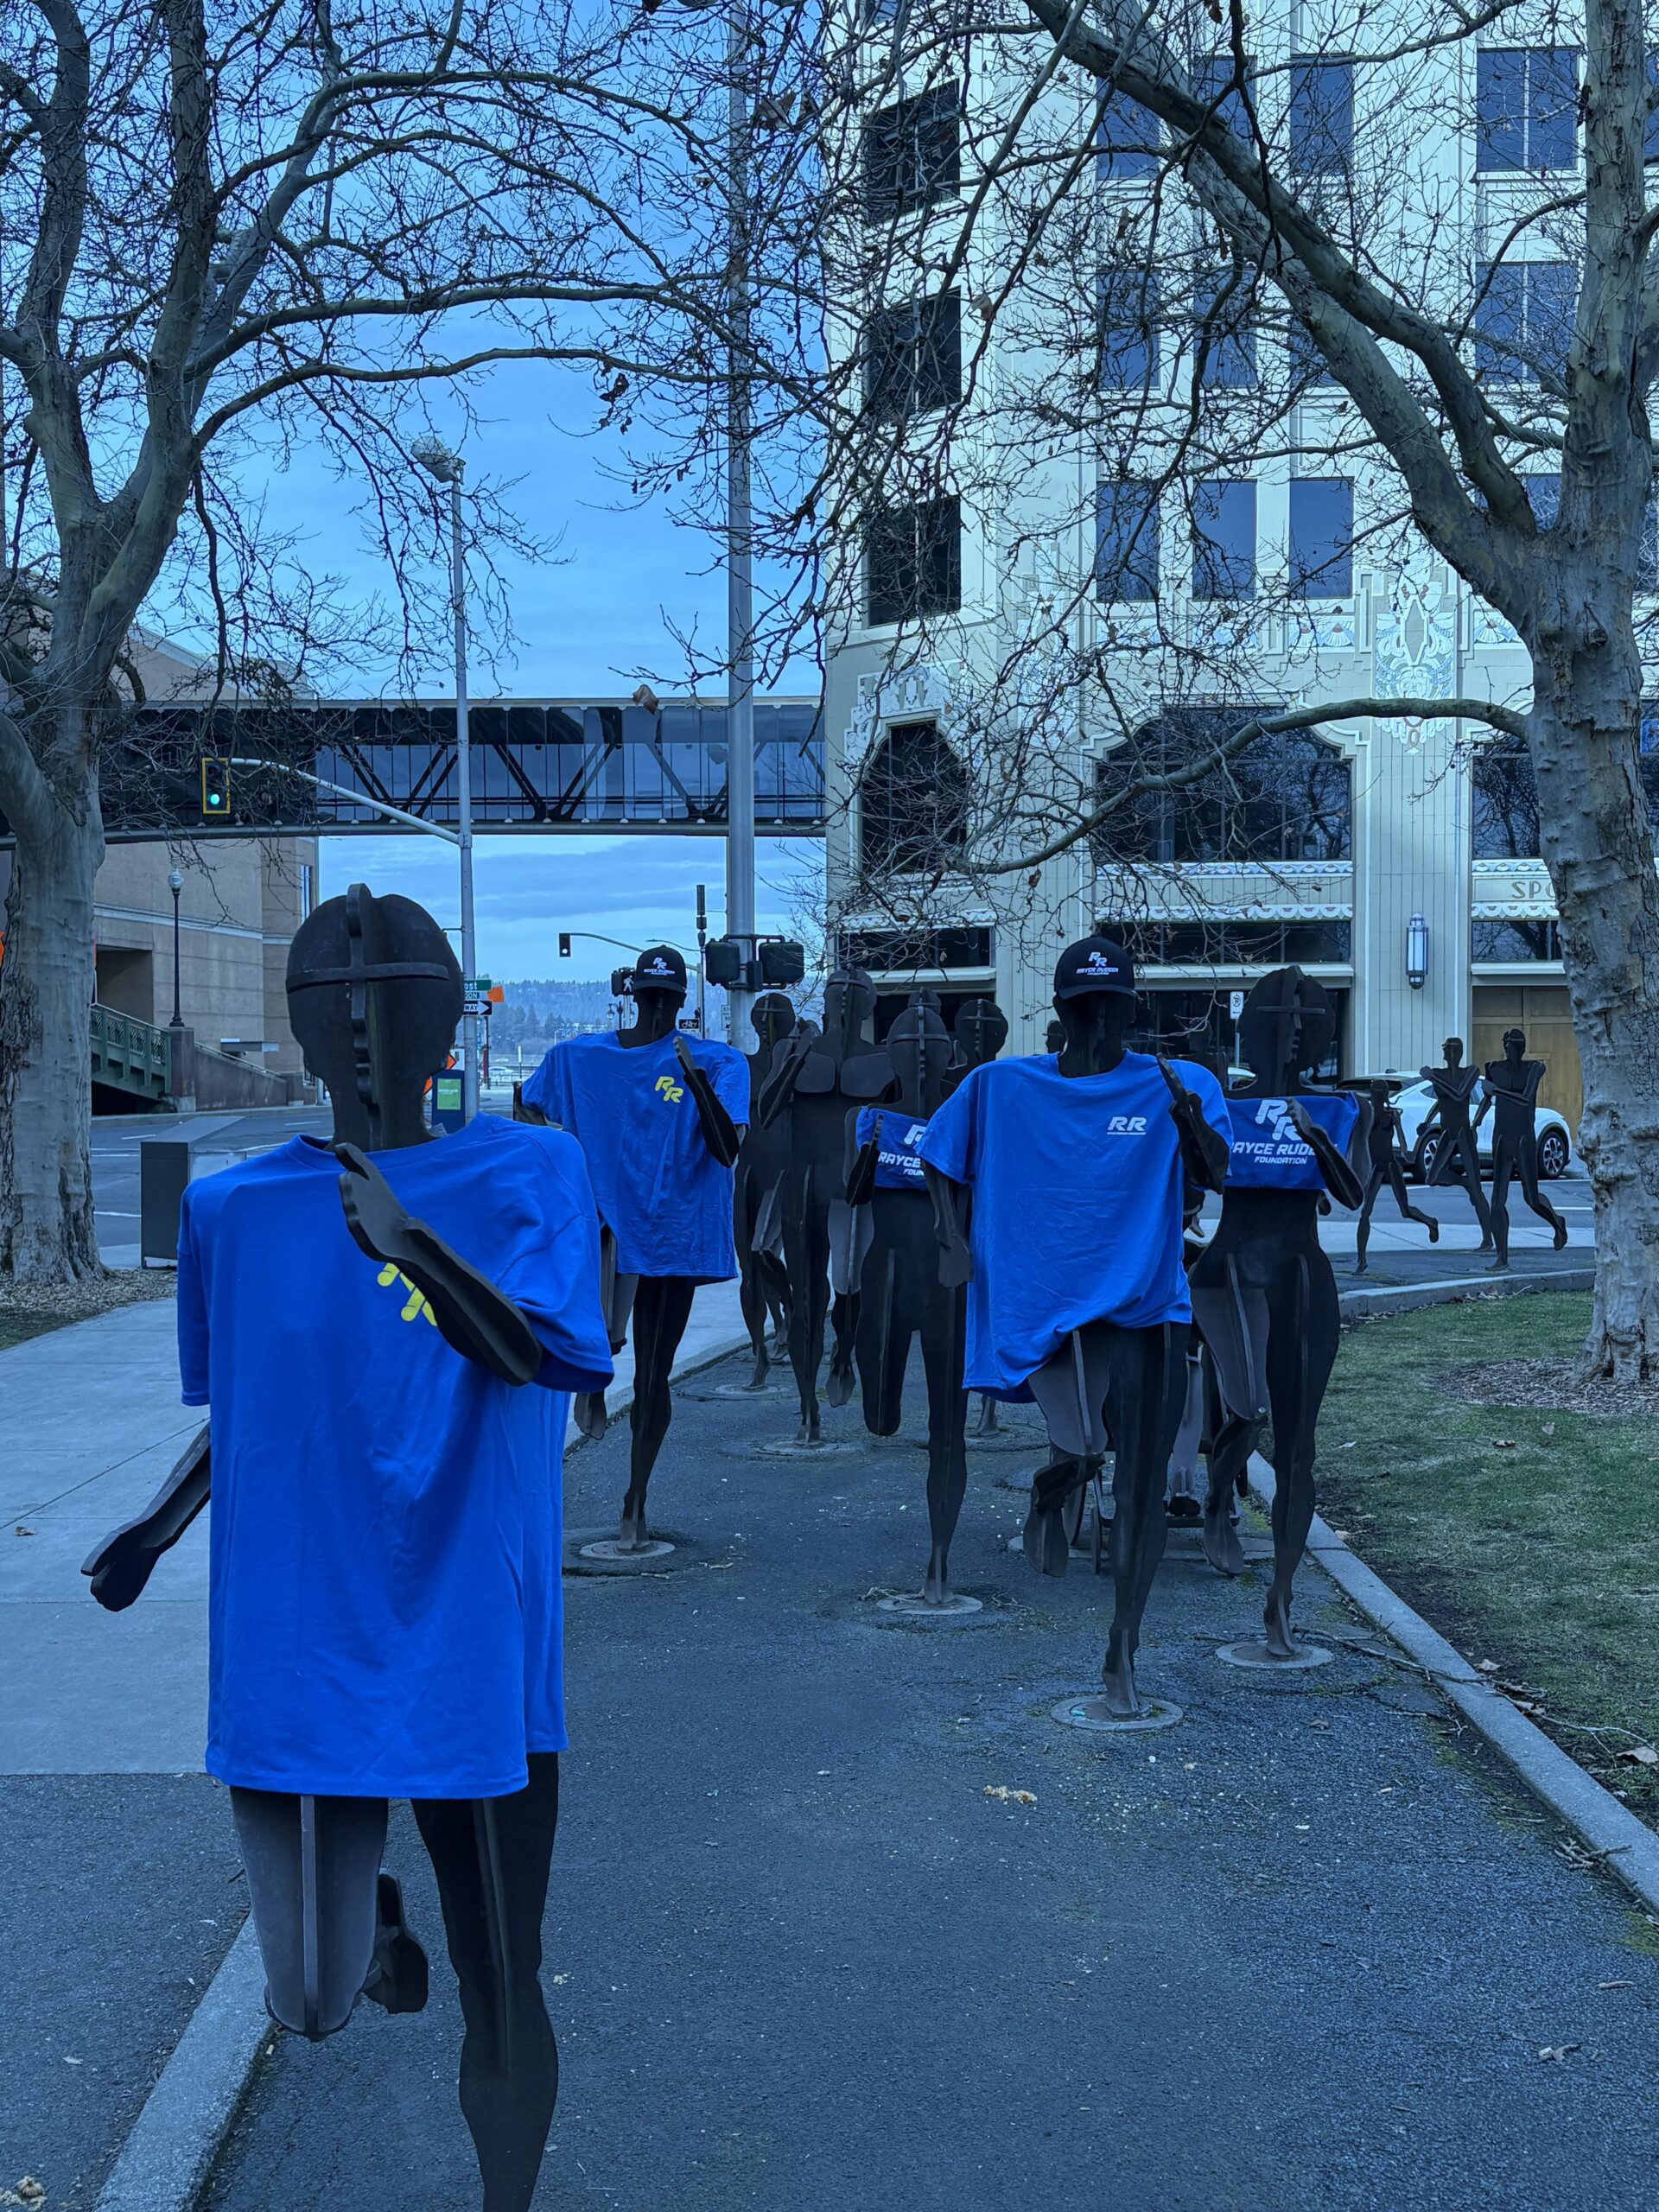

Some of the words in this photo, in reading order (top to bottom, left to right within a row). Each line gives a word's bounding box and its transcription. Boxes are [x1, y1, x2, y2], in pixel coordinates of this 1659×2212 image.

[654, 1076, 684, 1103] RR
[1107, 1116, 1147, 1132] RR
[1230, 1141, 1275, 1156] AYCE
[877, 1151, 922, 1168] RAYCE
[1254, 1155, 1308, 1165] FOUNDATION
